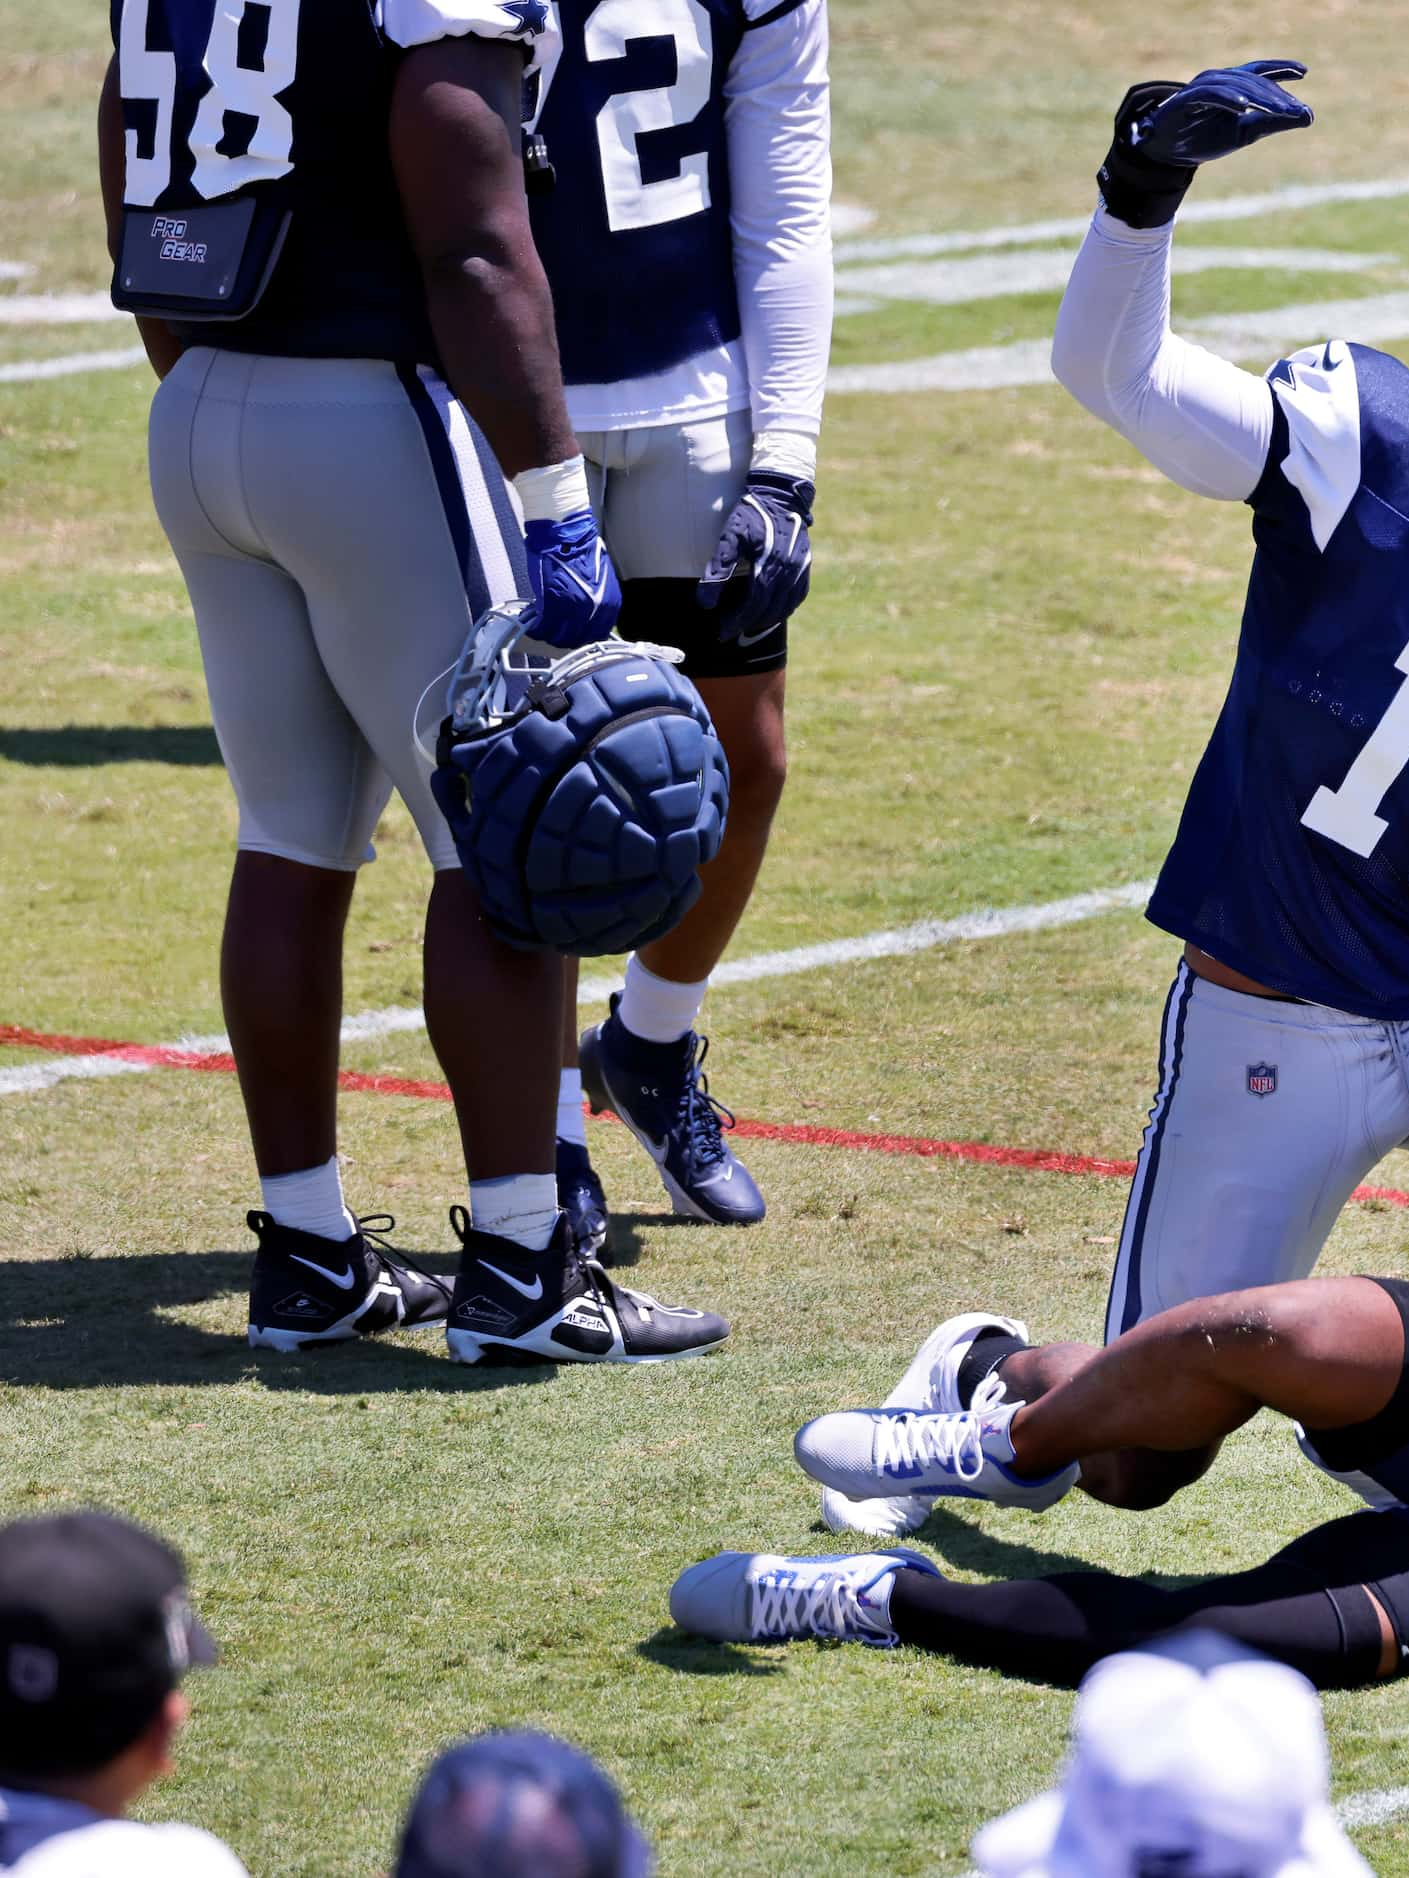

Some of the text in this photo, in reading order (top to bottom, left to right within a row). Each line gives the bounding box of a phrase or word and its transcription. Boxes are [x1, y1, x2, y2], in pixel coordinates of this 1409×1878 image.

[119, 0, 300, 208] 58
[521, 0, 713, 233] 2
[151, 216, 188, 239] PRO
[160, 239, 208, 264] GEAR
[1250, 1077, 1275, 1093] NFL
